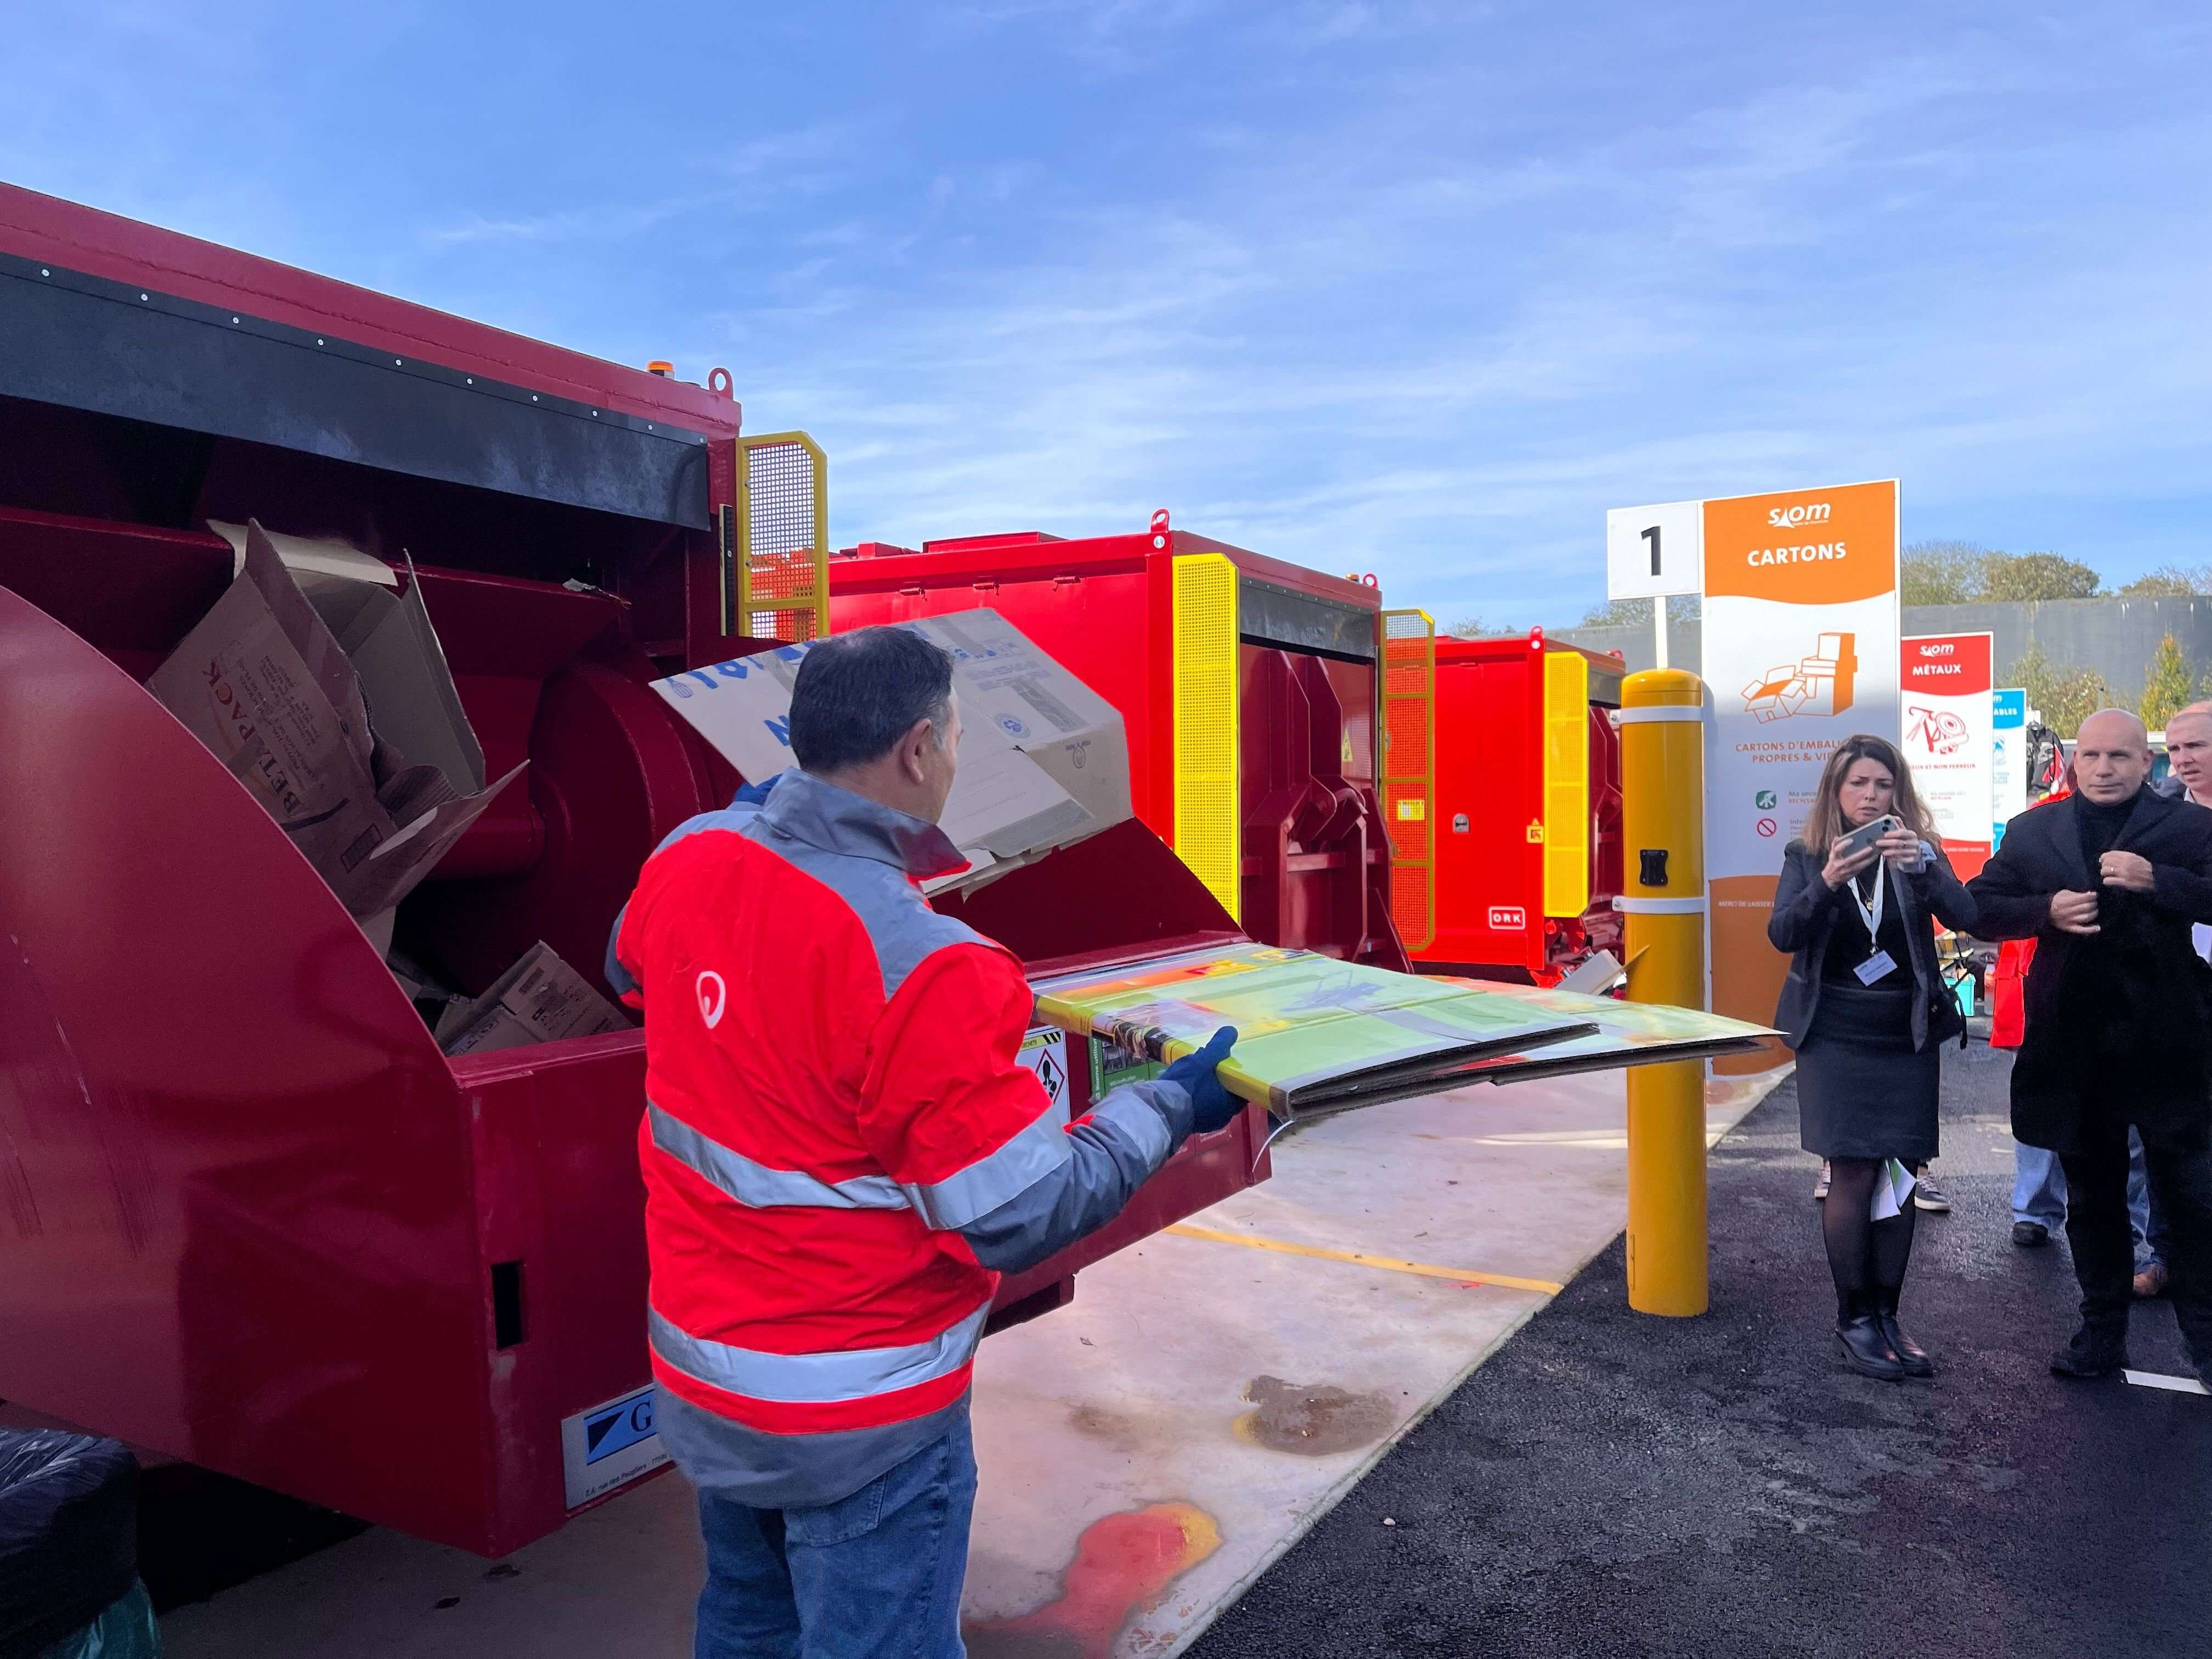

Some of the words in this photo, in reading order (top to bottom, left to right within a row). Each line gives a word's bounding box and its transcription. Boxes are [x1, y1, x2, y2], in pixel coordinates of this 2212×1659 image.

[1641, 526, 1661, 576] 1
[1747, 542, 1847, 567] CARTONS
[1912, 664, 1961, 676] MÉTAUX
[1994, 708, 2017, 716] ABLES
[202, 661, 303, 813] BETPACK
[1736, 742, 1785, 752] CARTONS
[1753, 754, 1799, 763] PROPRES
[1803, 753, 1812, 761] &
[631, 1401, 652, 1432] G
